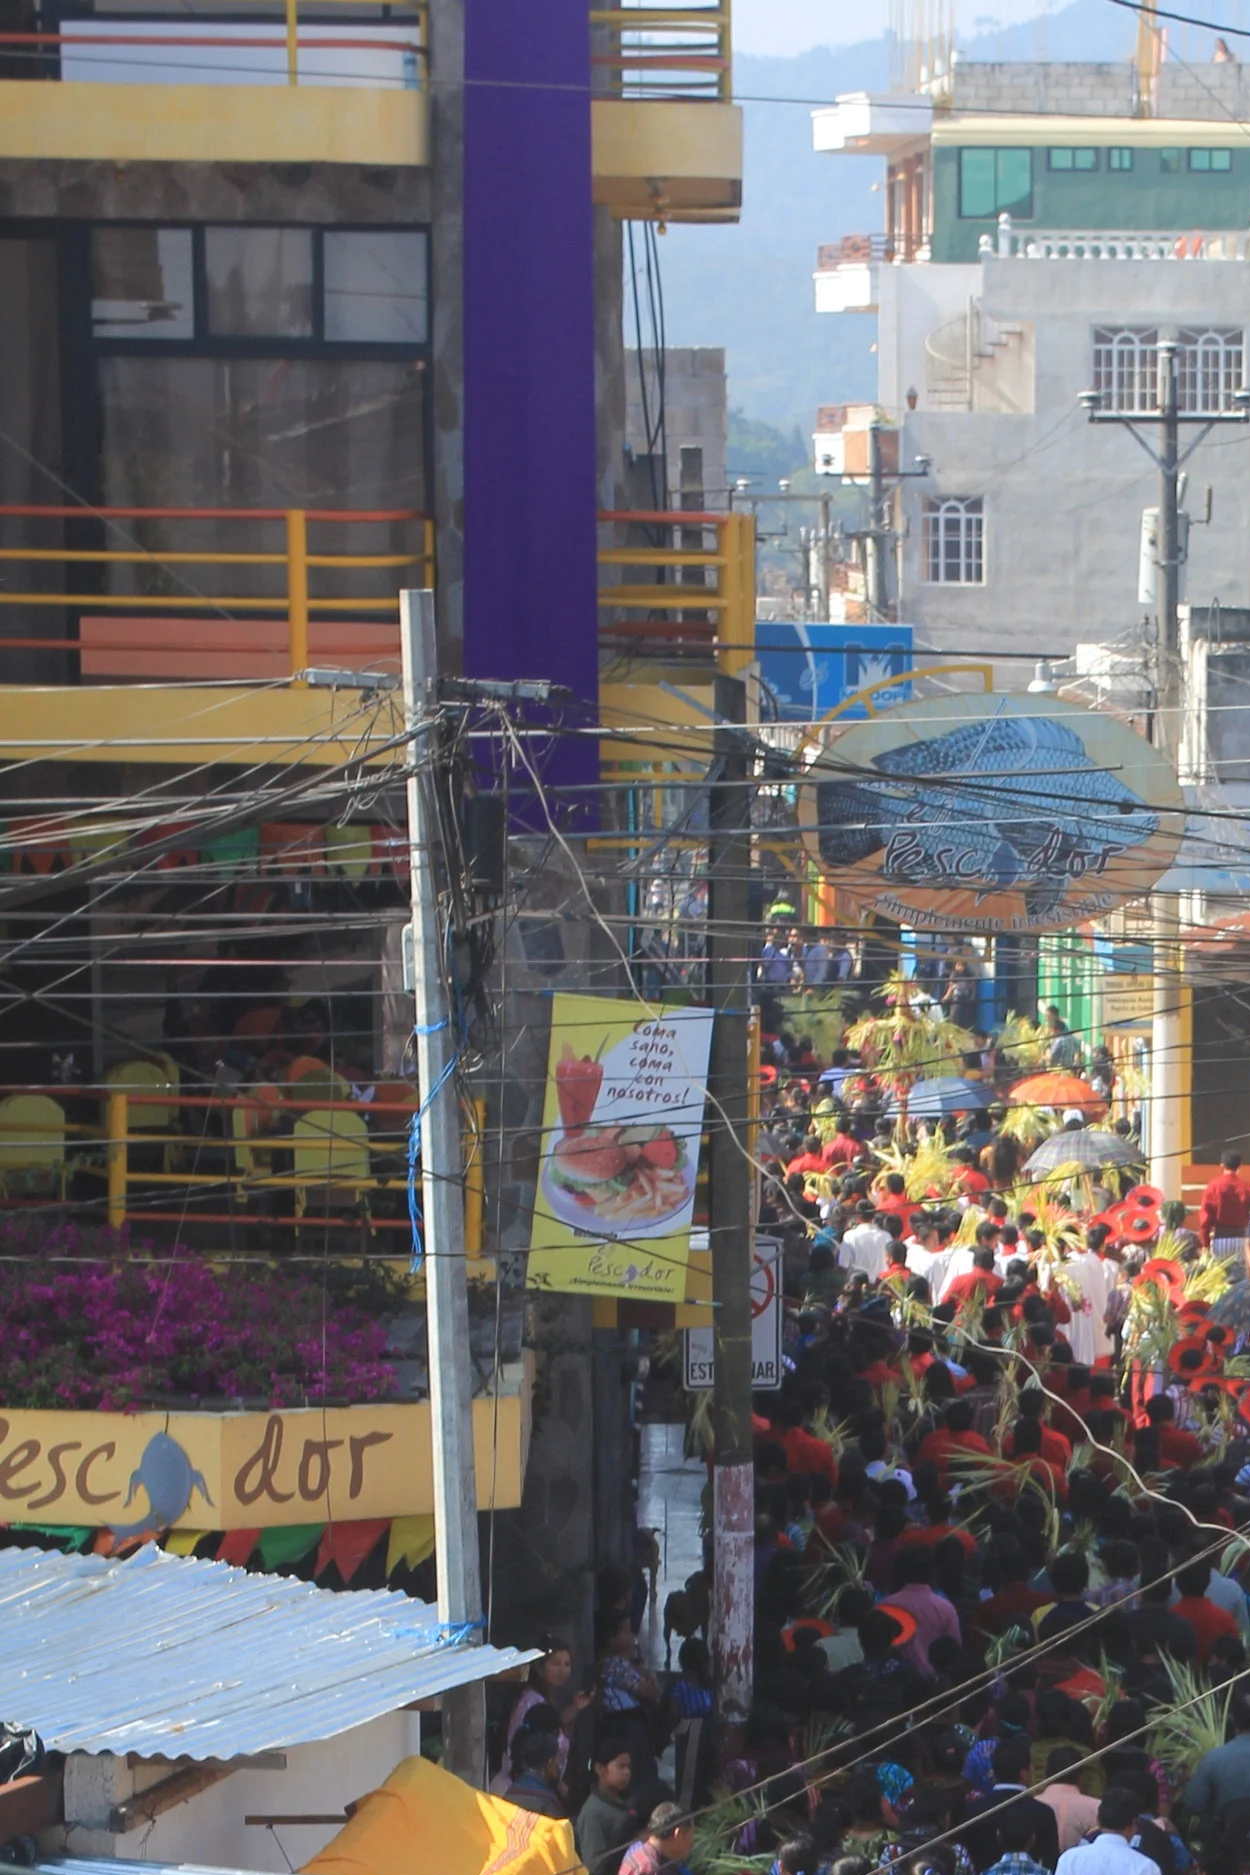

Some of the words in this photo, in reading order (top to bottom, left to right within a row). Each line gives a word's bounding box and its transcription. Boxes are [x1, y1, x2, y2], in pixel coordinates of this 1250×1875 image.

[633, 1018, 676, 1040] Coma
[629, 1040, 674, 1057] sano,
[629, 1057, 673, 1073] coma
[634, 1074, 665, 1087] con
[607, 1087, 689, 1104] nosotros!
